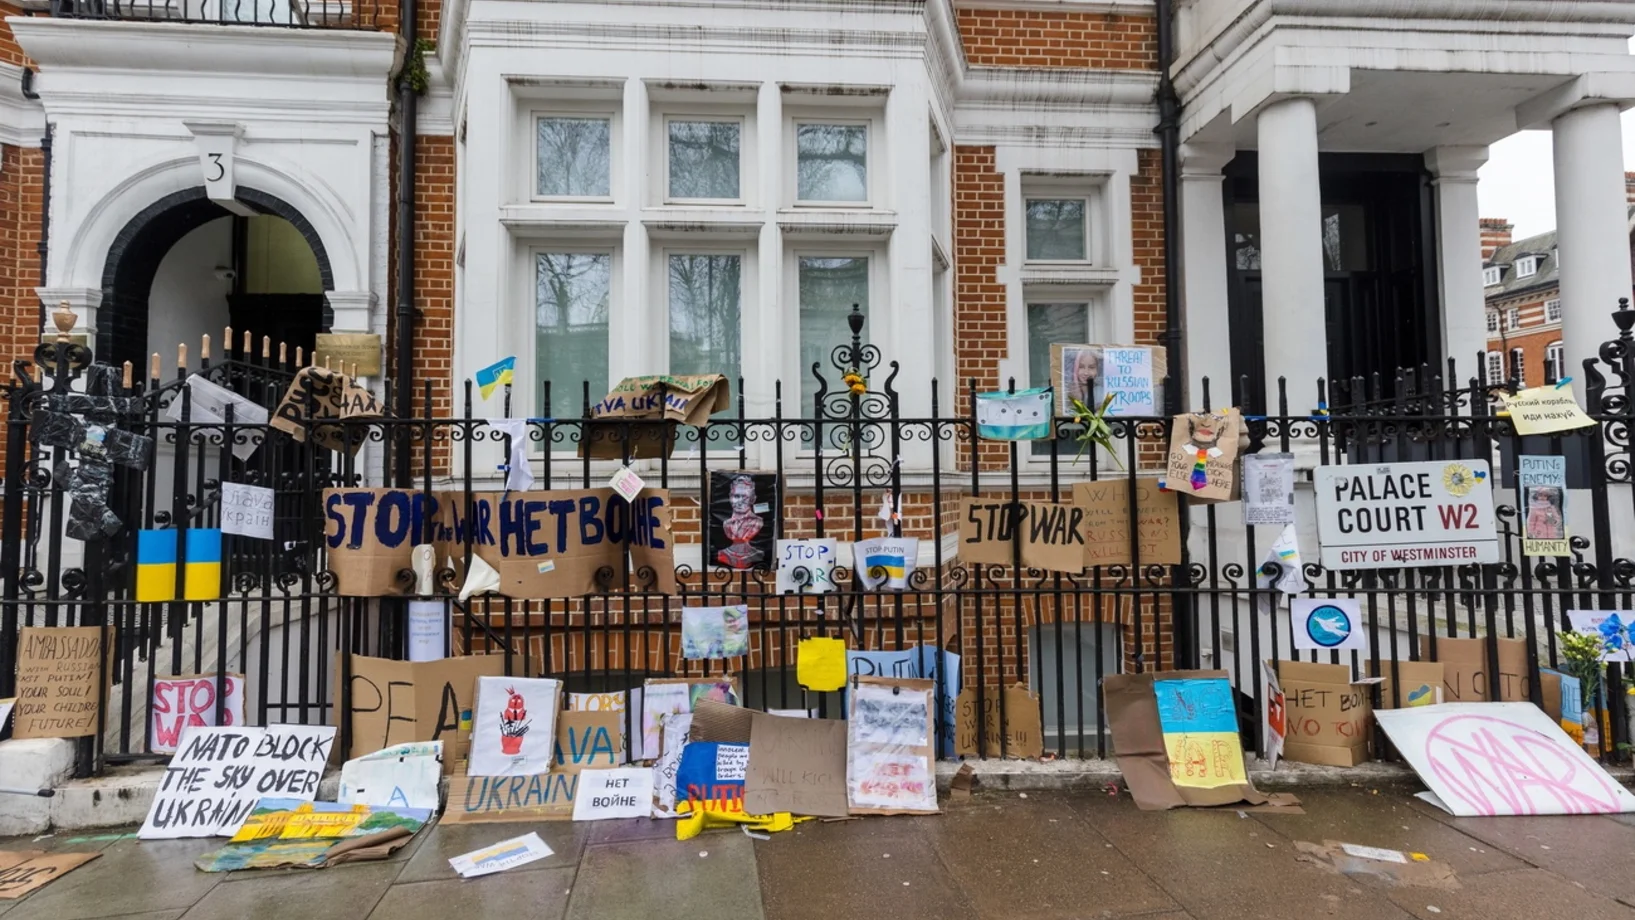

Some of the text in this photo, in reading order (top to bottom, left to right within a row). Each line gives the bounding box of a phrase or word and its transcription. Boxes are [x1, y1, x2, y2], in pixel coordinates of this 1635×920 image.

[206, 154, 225, 182] 3
[1106, 350, 1147, 364] THREAT
[1117, 364, 1132, 375] TO
[1106, 376, 1149, 388] RUSSIAN
[1522, 409, 1576, 421] иди нахуй
[1085, 485, 1150, 502] WHO
[1335, 473, 1432, 501] PALACE
[326, 490, 438, 549] STOP
[452, 499, 495, 546] WAR
[966, 502, 1085, 545] STOP WAR
[1338, 503, 1480, 533] COURT W2
[499, 499, 576, 557] НЕТ
[785, 545, 829, 560] STOP
[865, 546, 905, 554] STOP PUTIN
[1341, 546, 1477, 563] CITY OF WESTMINSTER
[1525, 541, 1568, 553] HUMANITY
[20, 685, 92, 698] YOUR SOUL!
[18, 702, 99, 716] YOUR CHILDRE
[27, 712, 96, 733] FUTURE!
[965, 715, 996, 730] WR
[1286, 716, 1320, 736] NO
[181, 732, 335, 762] NATO BLOCK
[162, 765, 320, 795] THE SKY OVER
[605, 777, 630, 789] НЕТ
[592, 793, 637, 808] ВОЙНЕ
